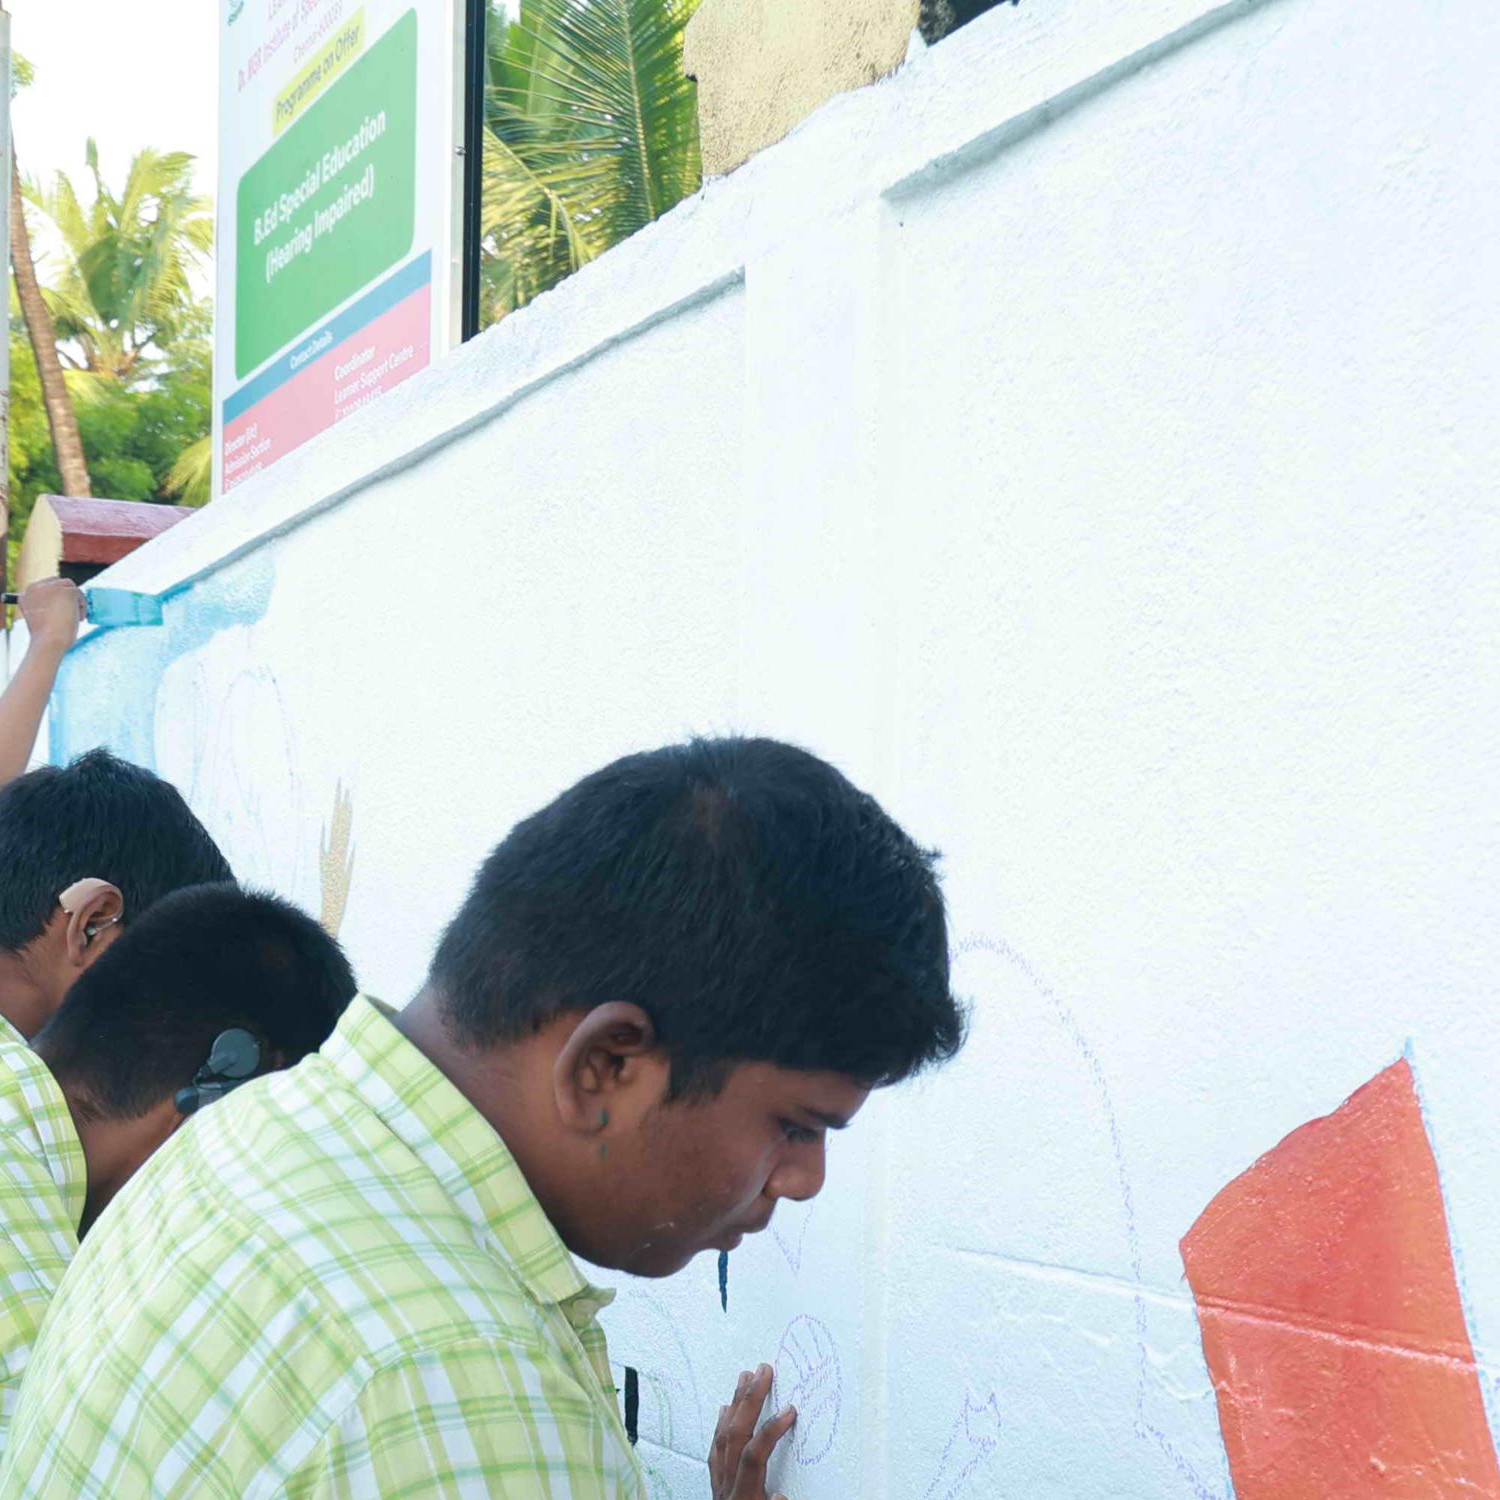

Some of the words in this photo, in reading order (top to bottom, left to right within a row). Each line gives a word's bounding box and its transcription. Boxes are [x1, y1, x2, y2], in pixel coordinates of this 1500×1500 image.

[275, 66, 323, 123] Programme
[323, 52, 335, 76] on
[334, 24, 361, 62] Offer
[253, 201, 279, 245] B.Ed
[279, 161, 321, 224] Special
[321, 110, 386, 184] Education
[266, 225, 313, 284] (Hearing
[314, 163, 375, 239] Impaired)
[333, 346, 377, 382] Coordinator
[333, 379, 362, 405] Learner
[360, 358, 389, 391] Support
[388, 345, 415, 370] Centre
